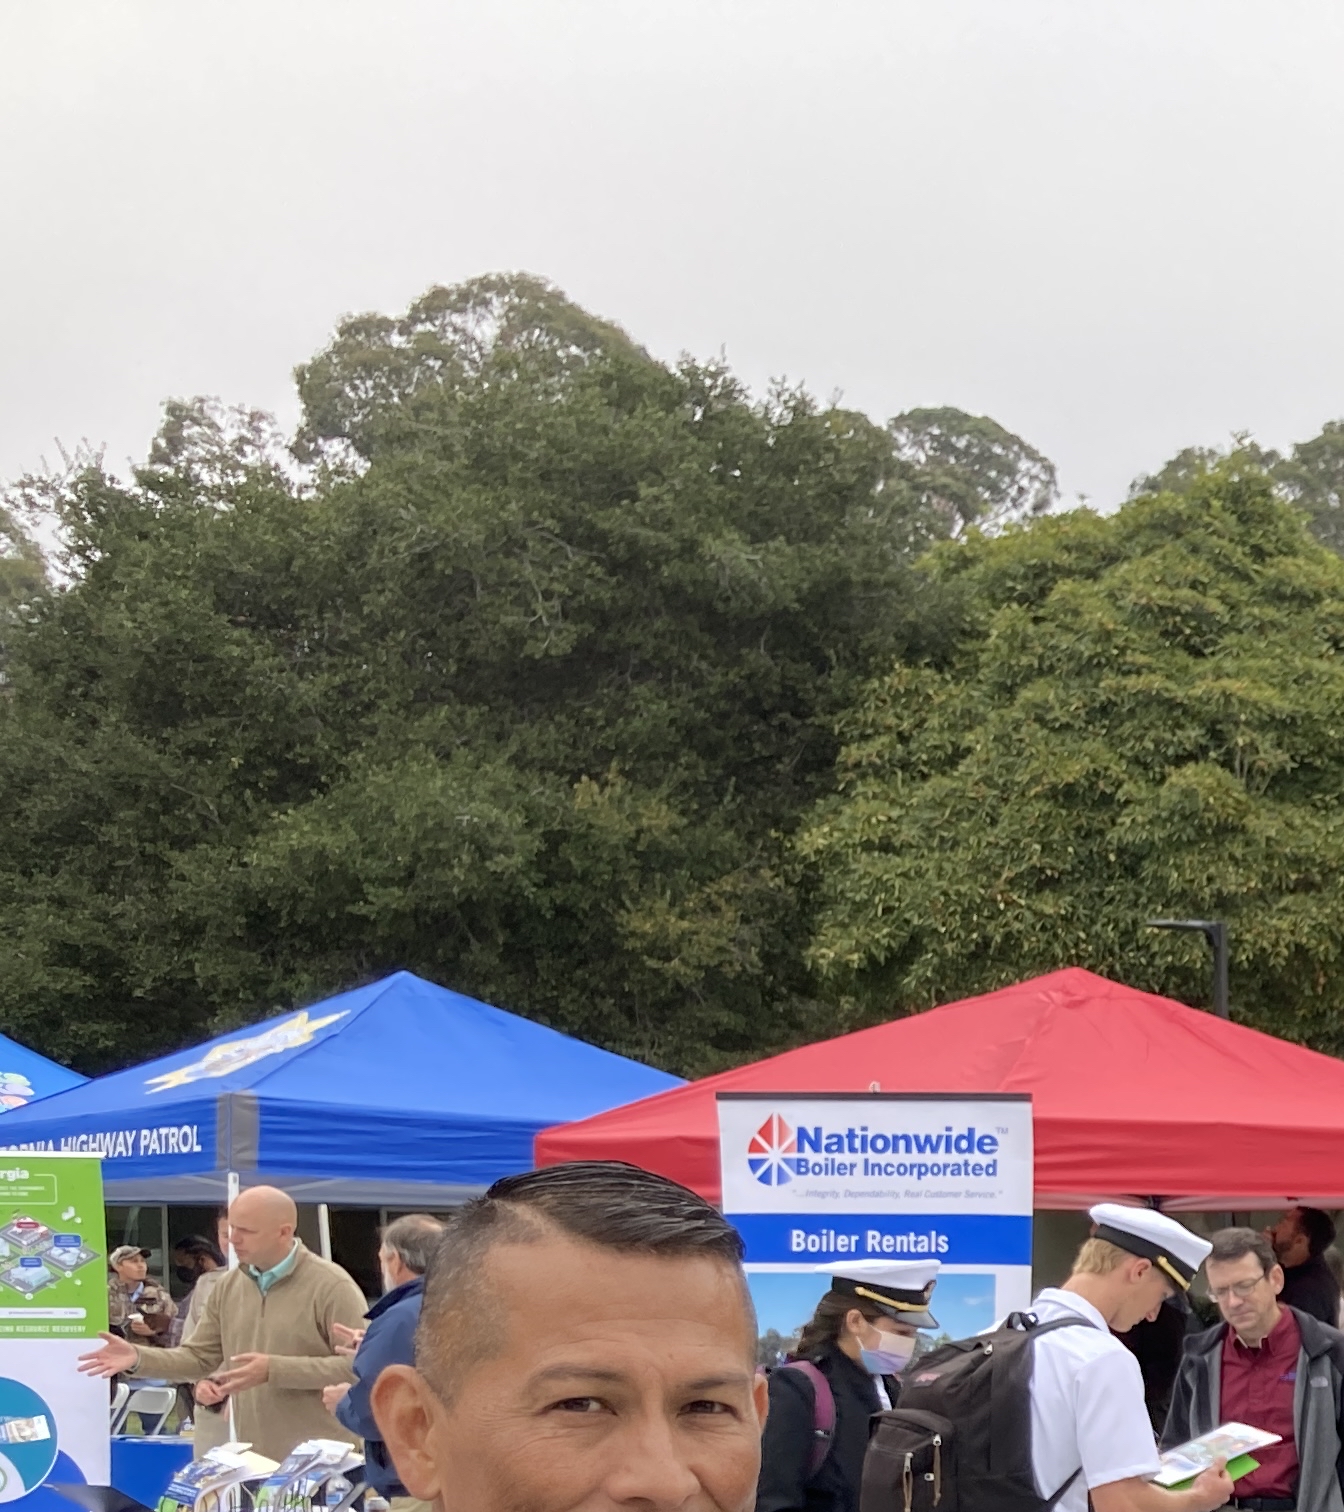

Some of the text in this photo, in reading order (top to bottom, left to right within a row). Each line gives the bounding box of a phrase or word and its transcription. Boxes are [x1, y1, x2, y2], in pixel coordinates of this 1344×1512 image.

[61, 1130, 136, 1158] HIGHWAY
[140, 1124, 201, 1156] PATROL
[797, 1126, 998, 1155] Nationwide
[796, 1157, 997, 1180] Boiler Incorporated
[790, 1229, 949, 1254] Boiler Rentals
